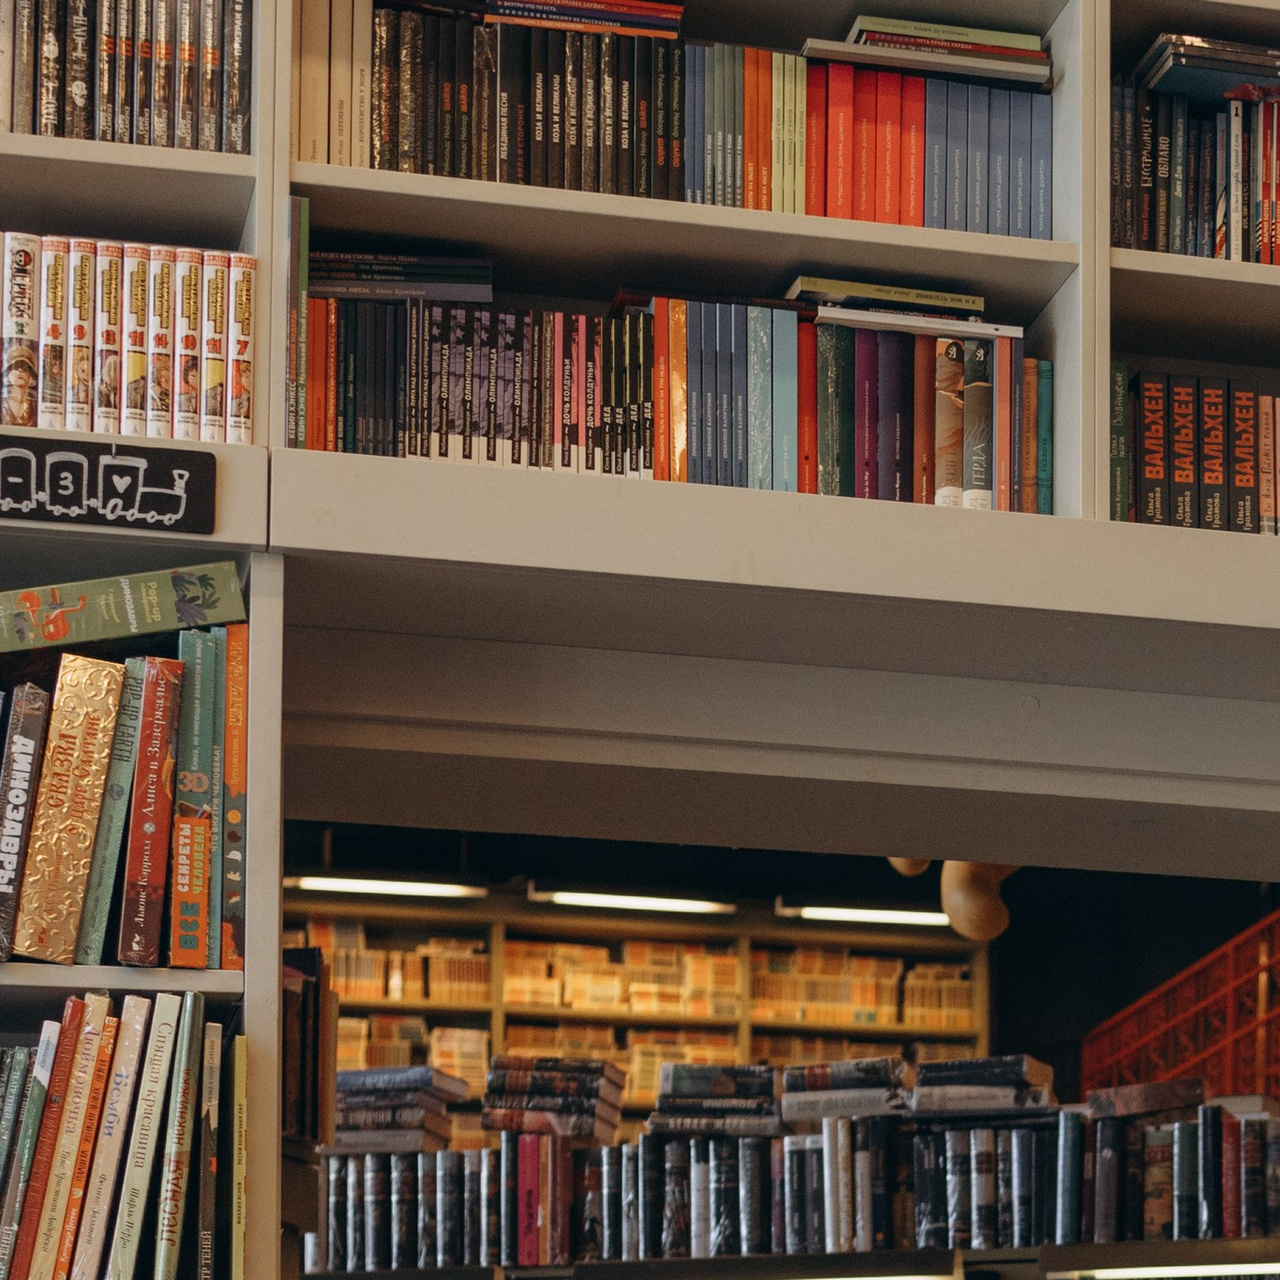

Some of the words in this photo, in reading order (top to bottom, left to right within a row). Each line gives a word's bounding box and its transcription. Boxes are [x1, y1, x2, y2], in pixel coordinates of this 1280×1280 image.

[460, 84, 468, 112] ШАЙЛО
[500, 93, 508, 116] ПЕСНЯ
[500, 117, 508, 160] ЛЕБЕДИНАЯ
[1158, 136, 1169, 177] ОБЛАКО
[237, 339, 248, 355] 7
[563, 359, 571, 401] КОЛДУНЬИ
[288, 413, 296, 439] КЕВИН
[563, 403, 571, 425] ДОЧЬ
[1144, 383, 1164, 479] ВАЛЬХЕН
[1174, 387, 1194, 483] ВАЛЬХЕН
[1204, 389, 1223, 484] ВАЛЬХЕН
[58, 472, 74, 495] 3
[1147, 493, 1155, 516] Ольга
[1154, 487, 1162, 522] Громова
[146, 675, 168, 758] Зазеркалье
[141, 773, 157, 817] Алиса
[179, 771, 209, 793] 3D
[0, 734, 36, 892] ДИНОЗАВРЫ
[136, 840, 153, 886] Кэрролл
[177, 823, 192, 893] СЕКРЕТЫ
[192, 826, 206, 893] ЧЕЛОВЕКА
[178, 903, 199, 950] ВСЕ
[148, 1022, 174, 1085] Спящая
[64, 1022, 102, 1135] Дюймовочка
[102, 1071, 130, 1137] Бемби
[132, 1089, 157, 1169] красавица
[126, 1187, 141, 1218] Шарль
[201, 1231, 212, 1265] ТЕНЕЙ
